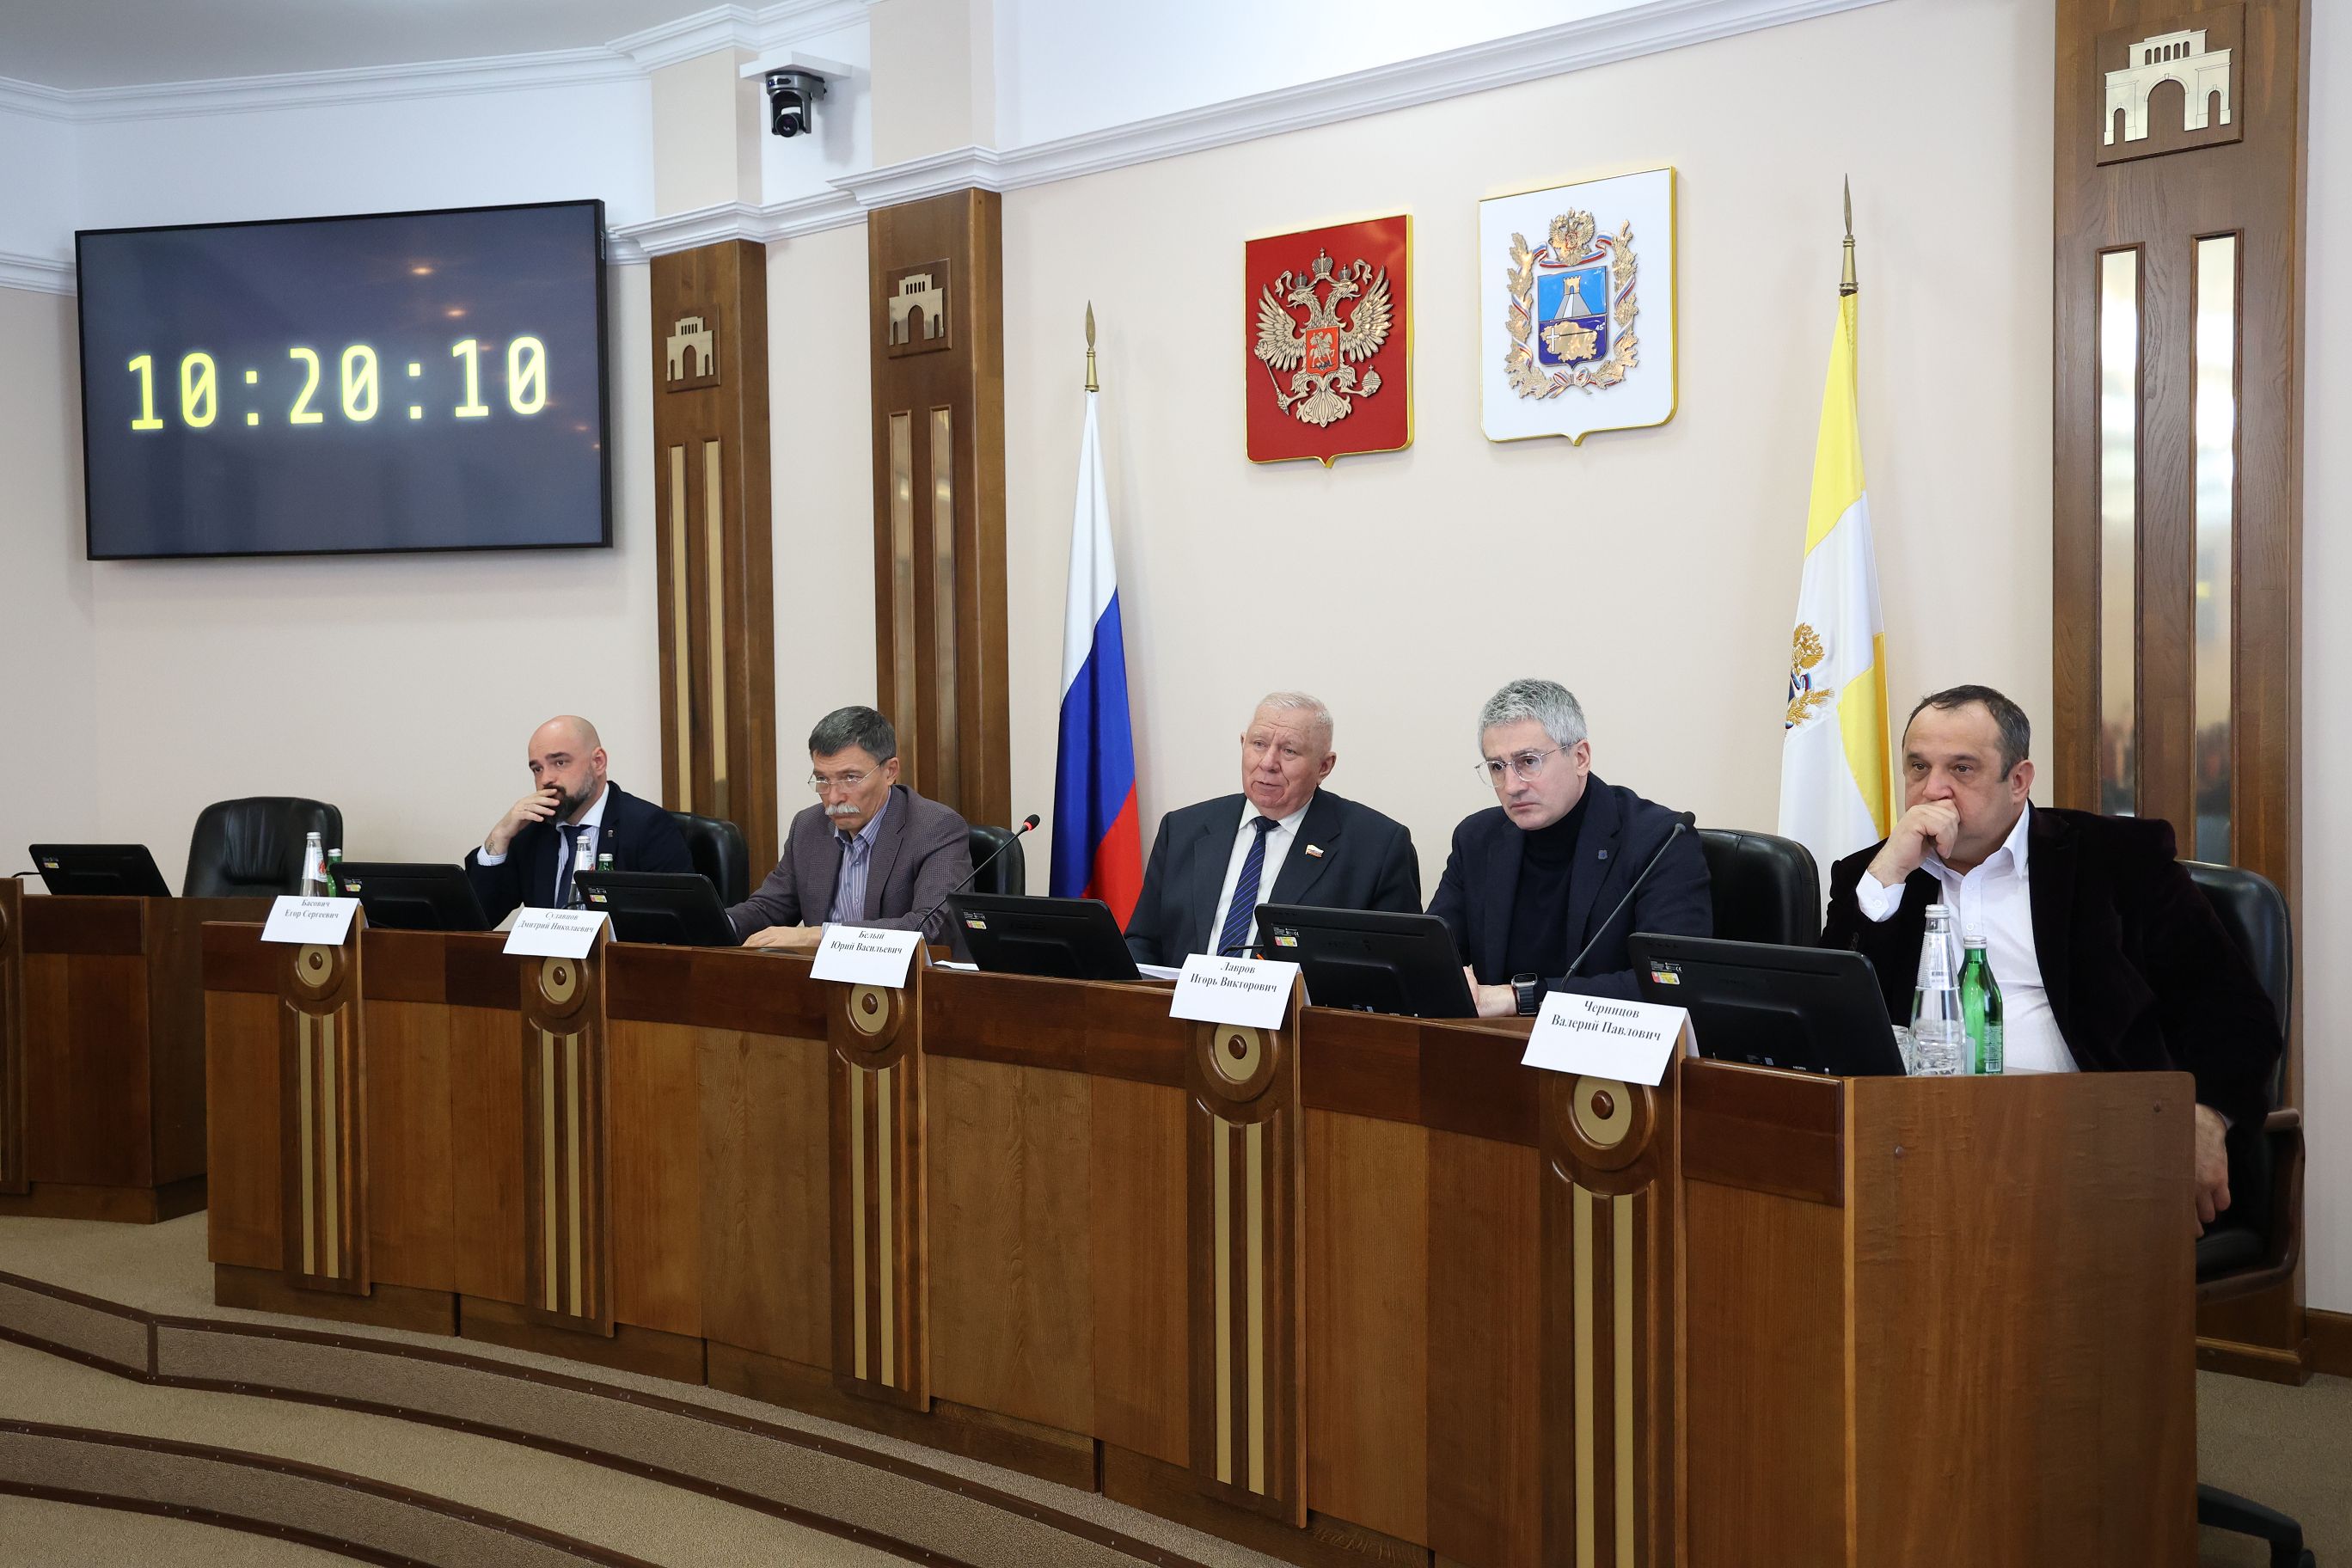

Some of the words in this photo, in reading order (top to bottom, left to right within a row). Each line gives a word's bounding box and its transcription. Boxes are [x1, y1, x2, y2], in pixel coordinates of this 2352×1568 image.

[128, 336, 547, 430] 10:20:10
[285, 910, 301, 919] Егор
[303, 910, 339, 919] Сергеевич
[518, 921, 550, 930] Дмитрий
[550, 922, 594, 933] Николаевич
[830, 940, 854, 952] Юрий
[856, 942, 903, 954] Васильевич
[1221, 962, 1255, 974] Лавров
[1190, 973, 1218, 986] Игорь
[1220, 977, 1277, 993] Викторович
[1551, 1014, 1599, 1032] Валерий
[1602, 1021, 1662, 1041] Павлович
